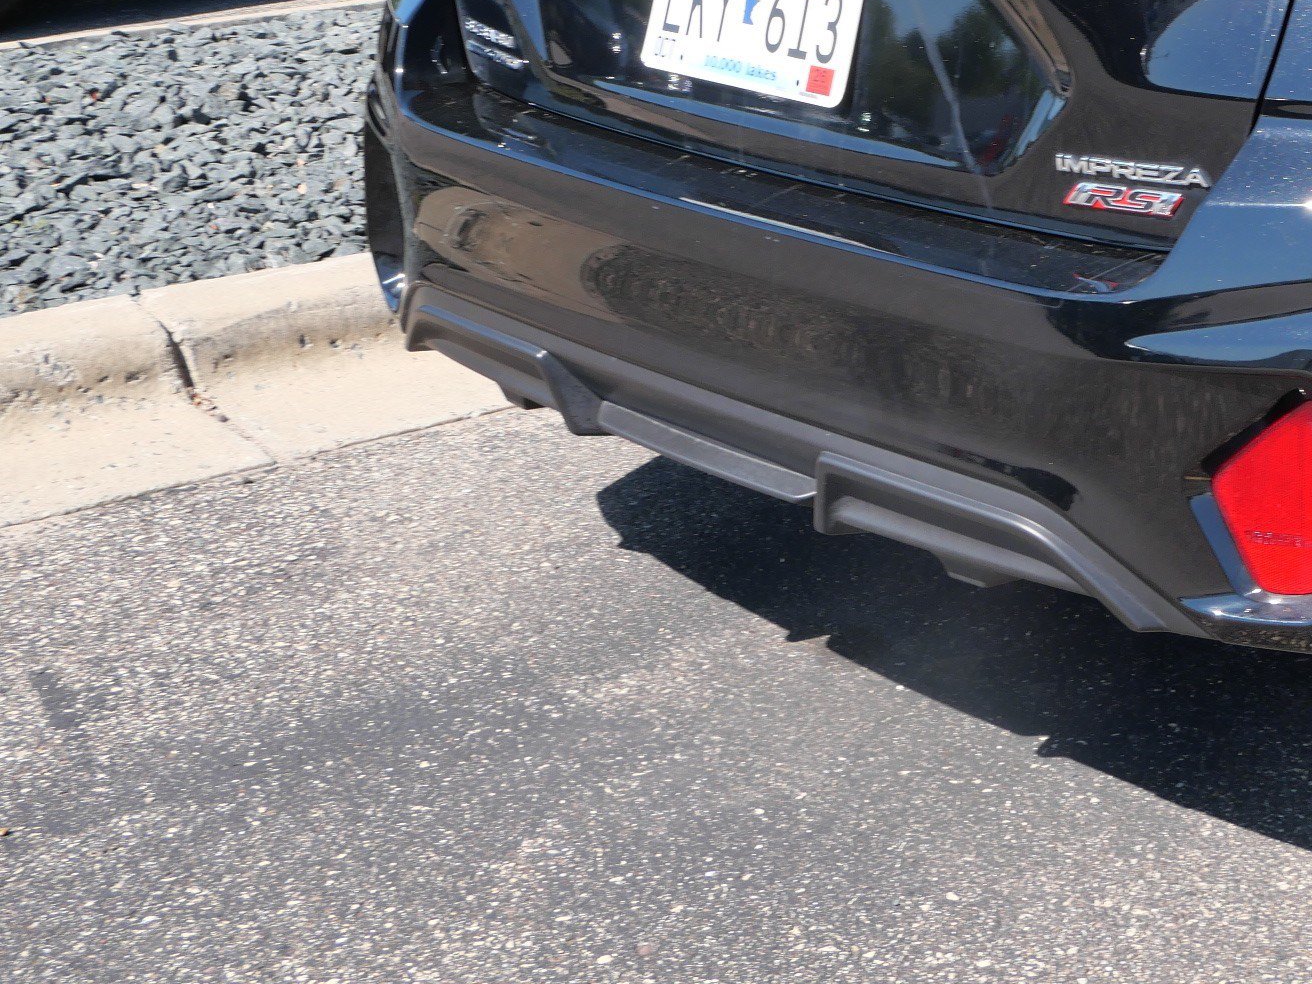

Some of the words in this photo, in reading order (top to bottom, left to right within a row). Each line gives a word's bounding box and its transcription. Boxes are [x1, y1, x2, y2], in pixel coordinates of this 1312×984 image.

[745, 62, 777, 81] lakes
[1055, 152, 1212, 189] IMPREZA
[1063, 181, 1185, 219] RS
